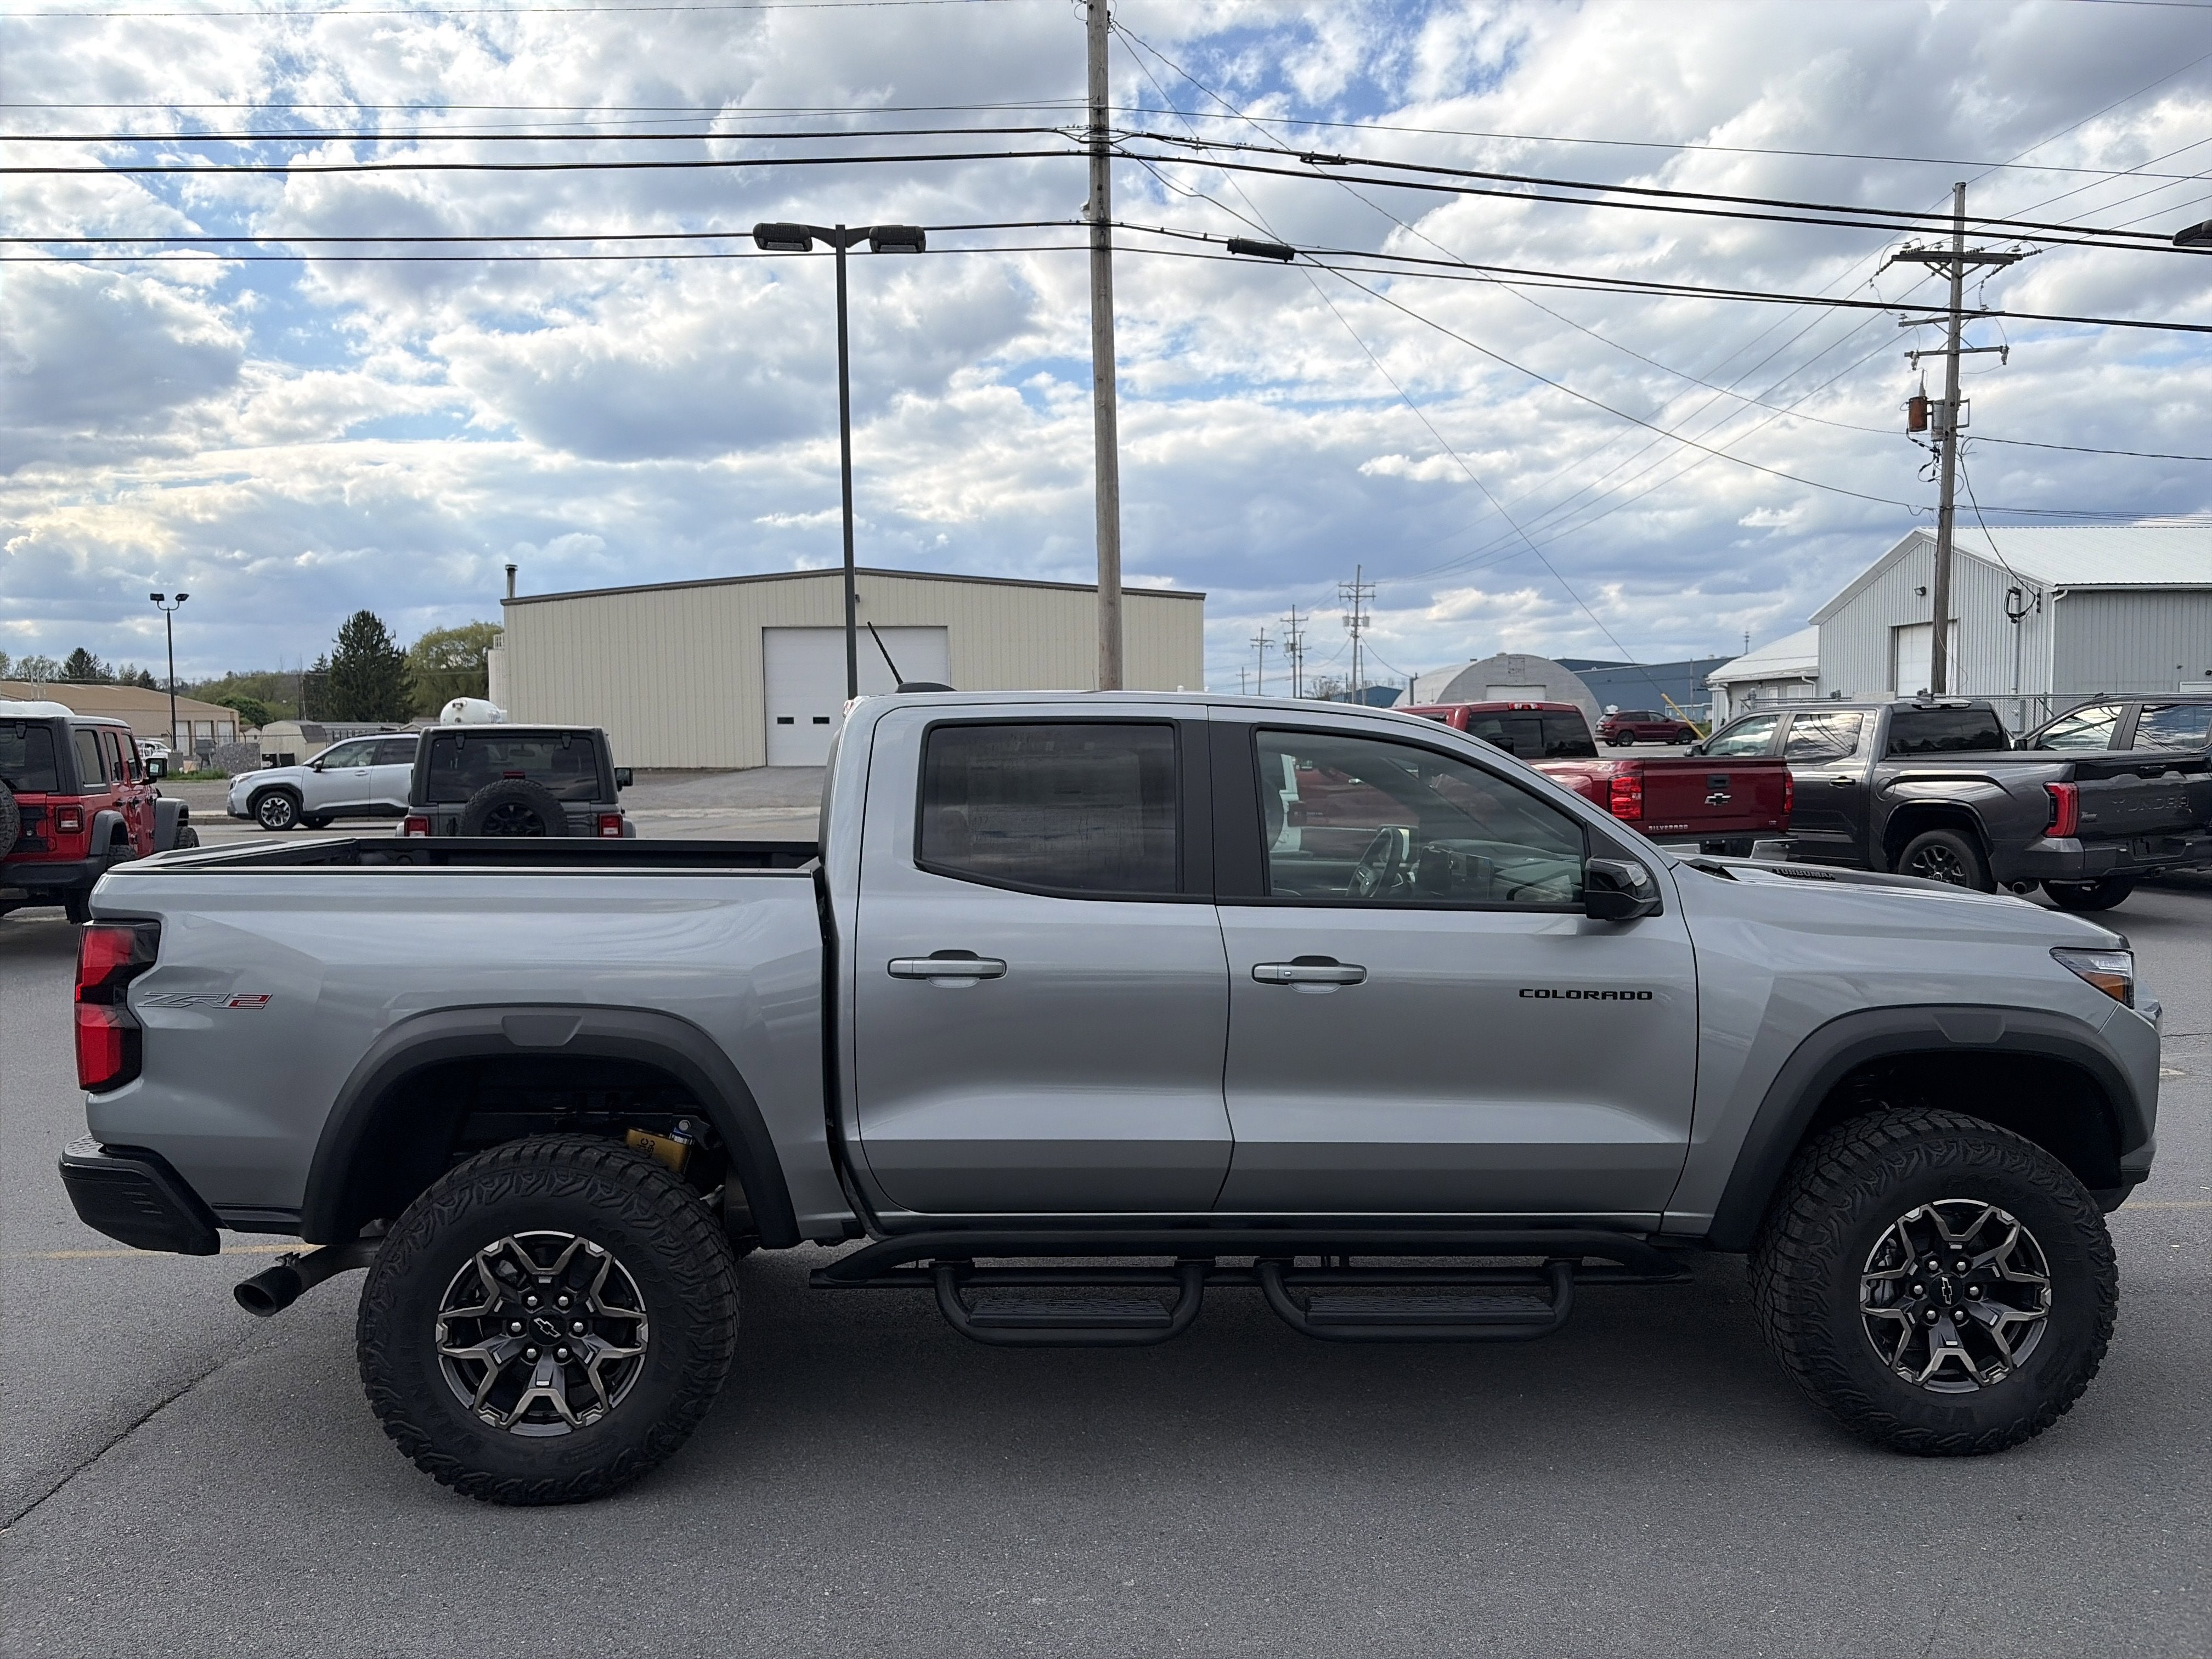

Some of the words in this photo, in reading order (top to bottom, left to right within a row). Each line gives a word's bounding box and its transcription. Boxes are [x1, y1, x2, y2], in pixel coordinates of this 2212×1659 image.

[1772, 868, 1836, 881] TURBOMAX
[137, 991, 273, 1009] ZR2
[1519, 989, 1652, 1000] COLORADO
